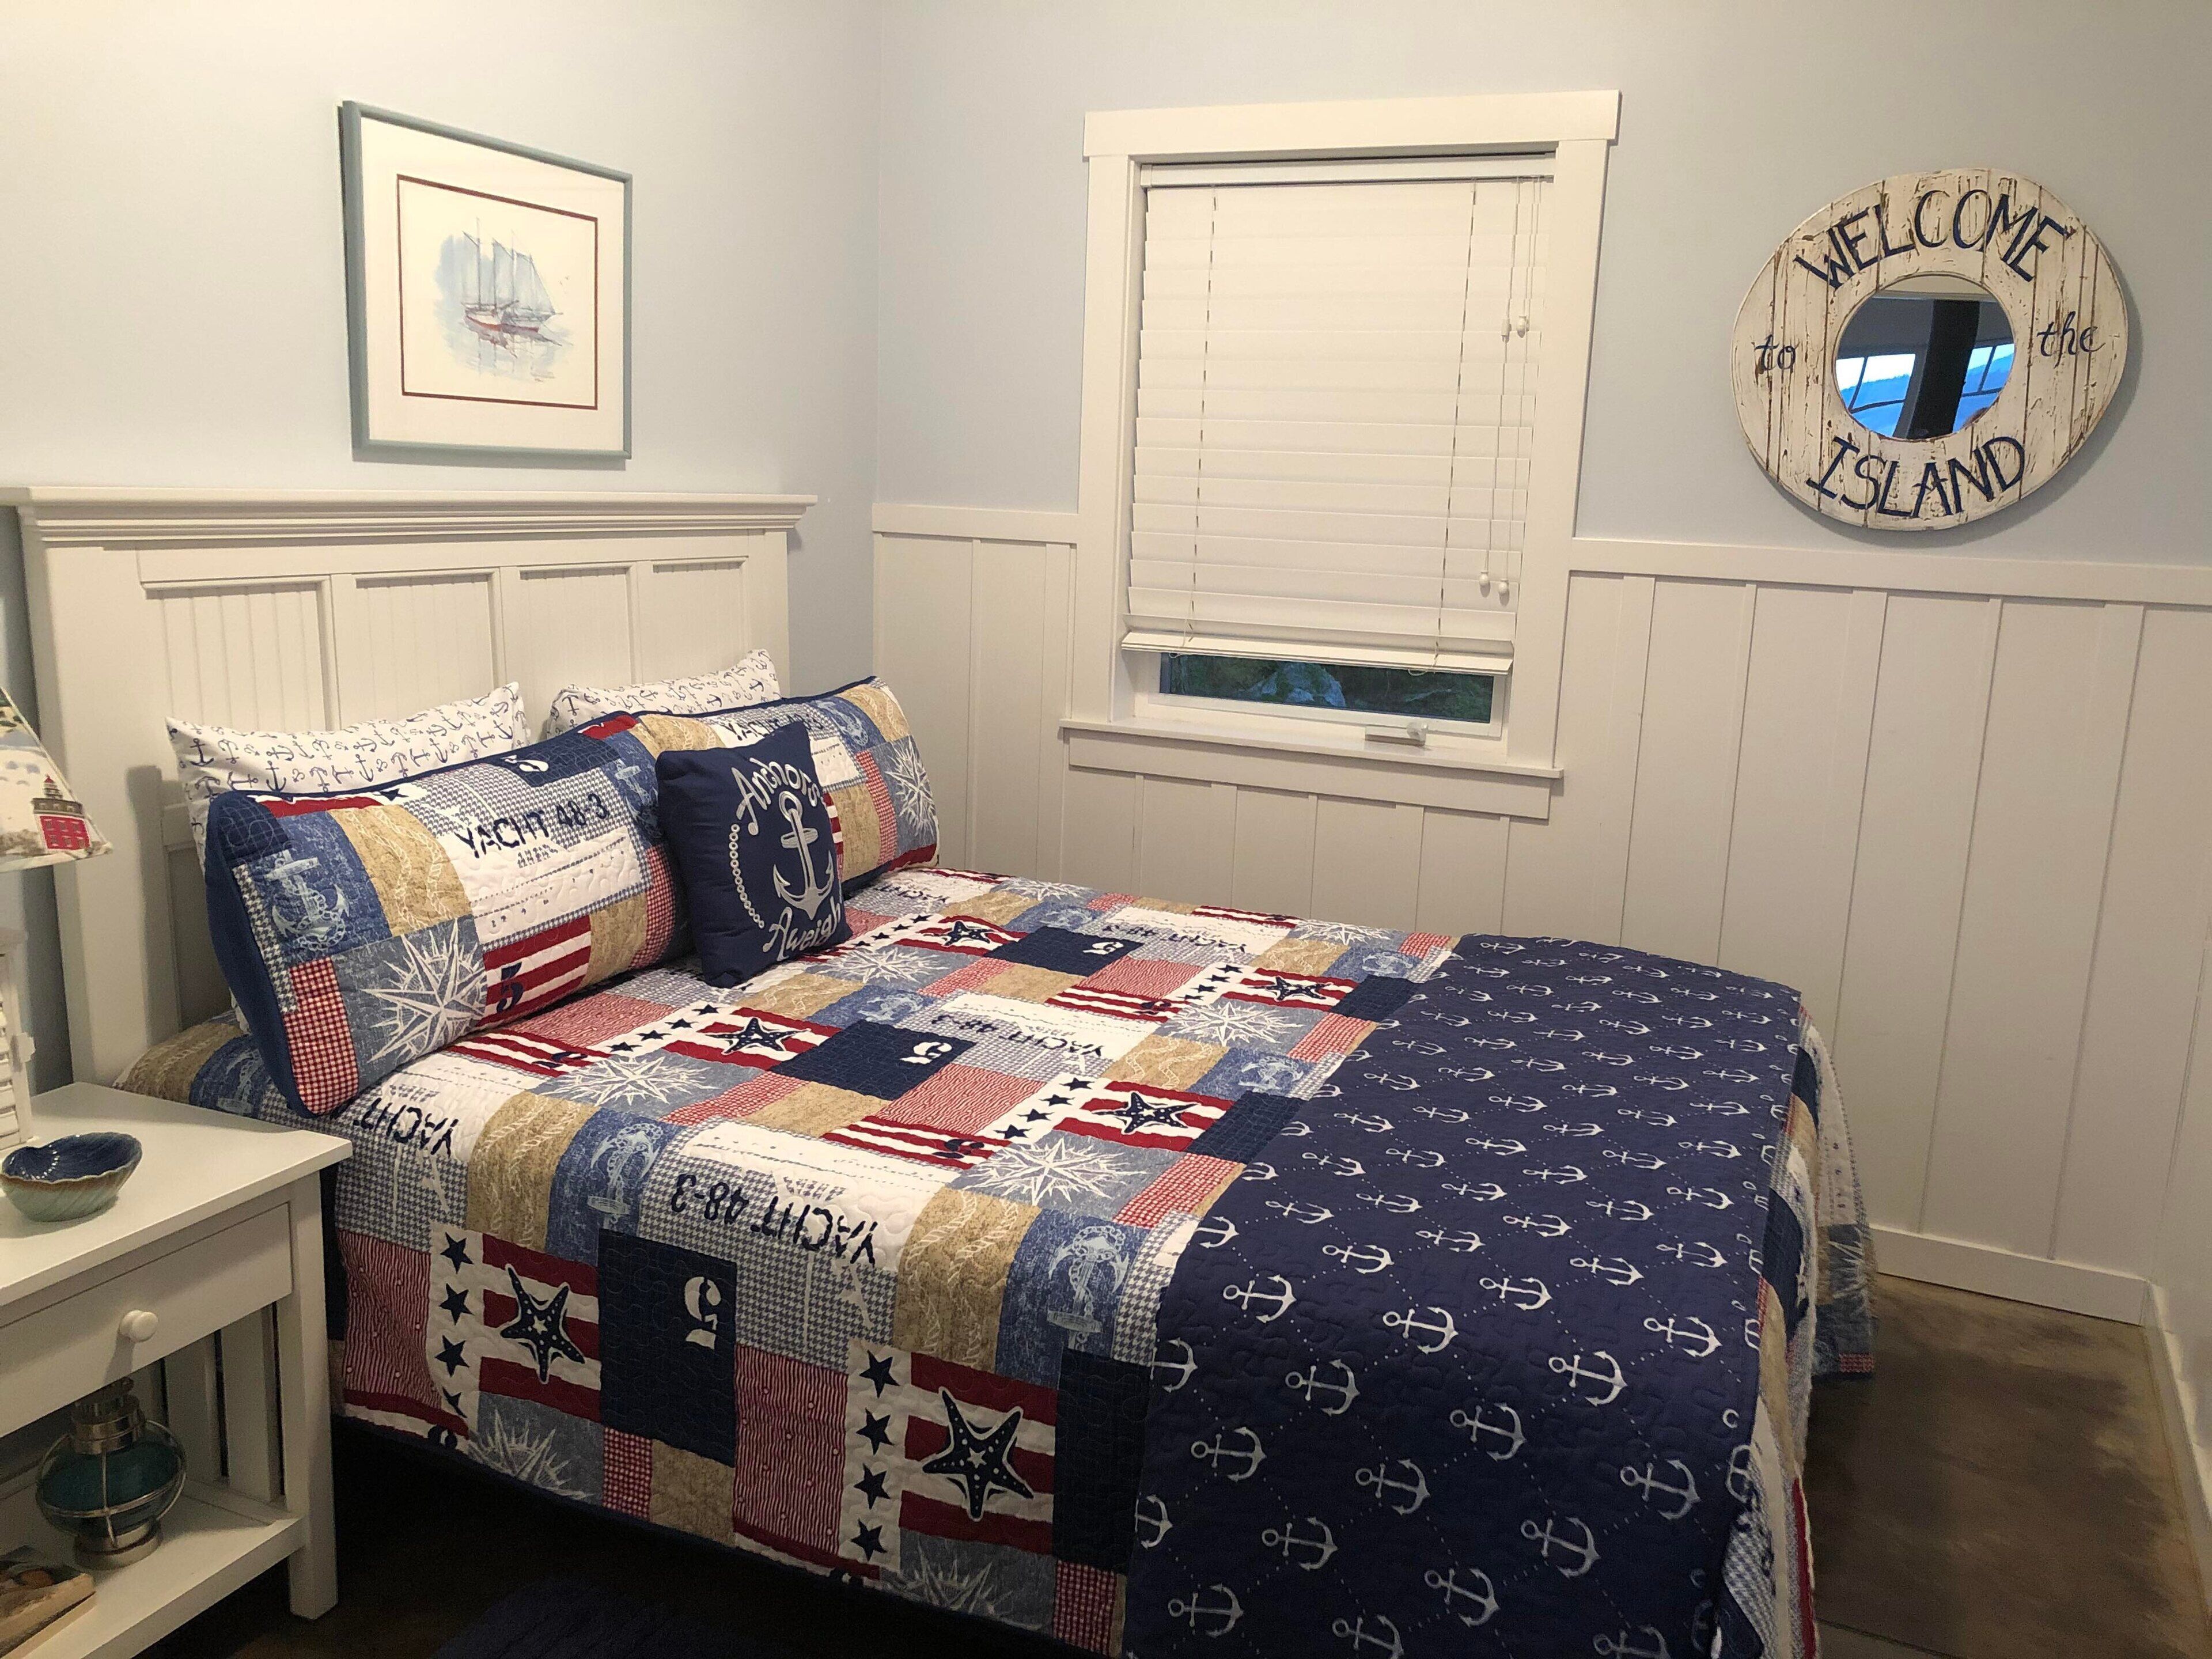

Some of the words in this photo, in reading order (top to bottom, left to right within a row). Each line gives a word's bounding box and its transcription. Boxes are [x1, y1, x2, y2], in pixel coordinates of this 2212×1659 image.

[1793, 188, 2074, 290] WELCOME
[1755, 336, 1797, 371] to
[2037, 311, 2106, 368] the
[1806, 437, 2025, 518] ISLAND
[454, 810, 550, 858] YACHT
[556, 793, 610, 827] 48-3
[731, 757, 820, 835] Anchors
[763, 896, 841, 961] Aweigh
[496, 961, 523, 1013] 5
[931, 1014, 998, 1033] 48-3
[998, 1030, 1104, 1057] YACHT
[353, 1097, 459, 1157] YACHT
[671, 1173, 749, 1224] 48-3
[751, 1195, 878, 1267] YACHT
[684, 1276, 721, 1350] 5
